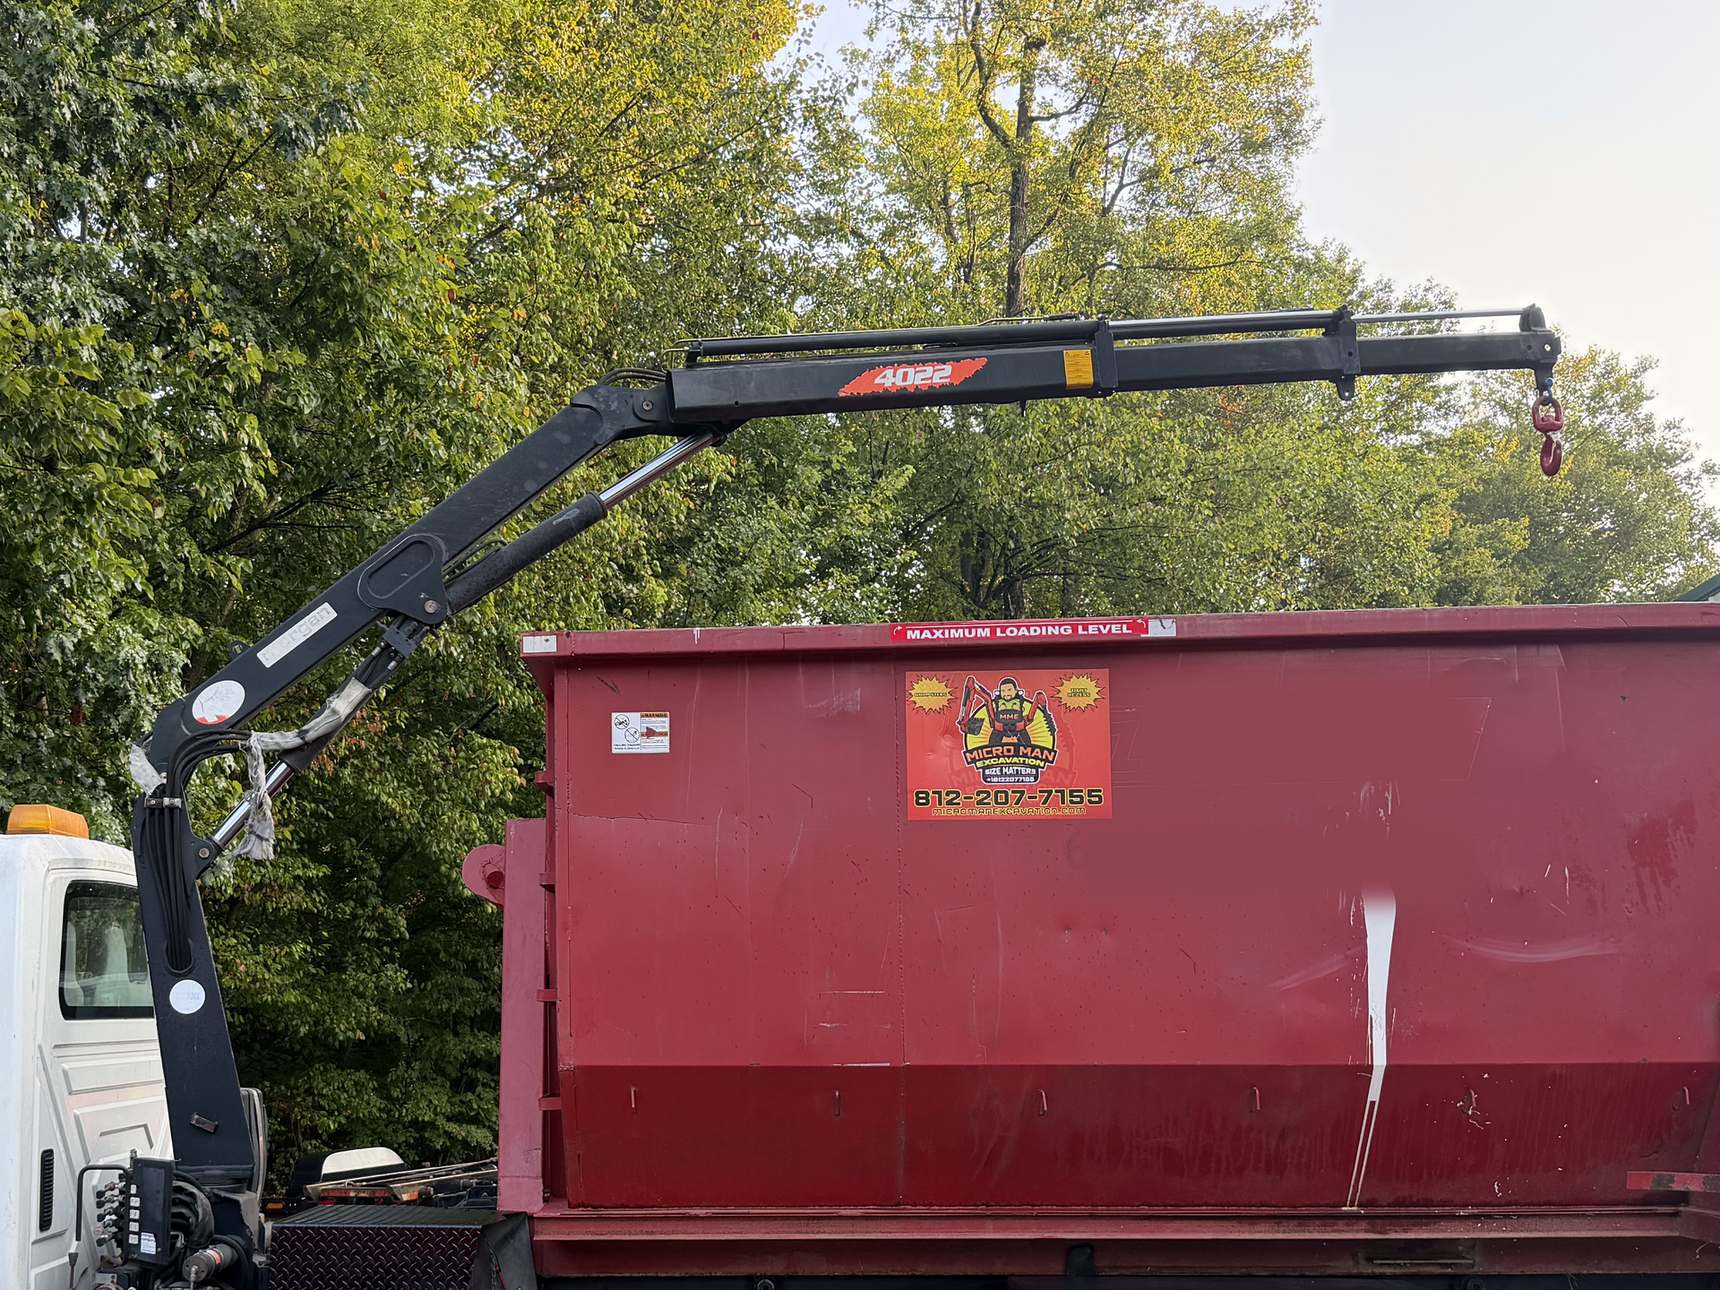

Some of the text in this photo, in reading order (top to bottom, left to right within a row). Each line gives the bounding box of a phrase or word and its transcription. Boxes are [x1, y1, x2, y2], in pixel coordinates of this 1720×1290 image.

[874, 364, 953, 387] 4022
[906, 623, 1132, 640] MAXIMUM LOADING LEVEL
[966, 746, 1055, 762] MICRO MAN
[976, 757, 1045, 767] EXCAVATION
[985, 767, 1001, 775] SIZE
[914, 788, 1104, 807] 812-207-7155
